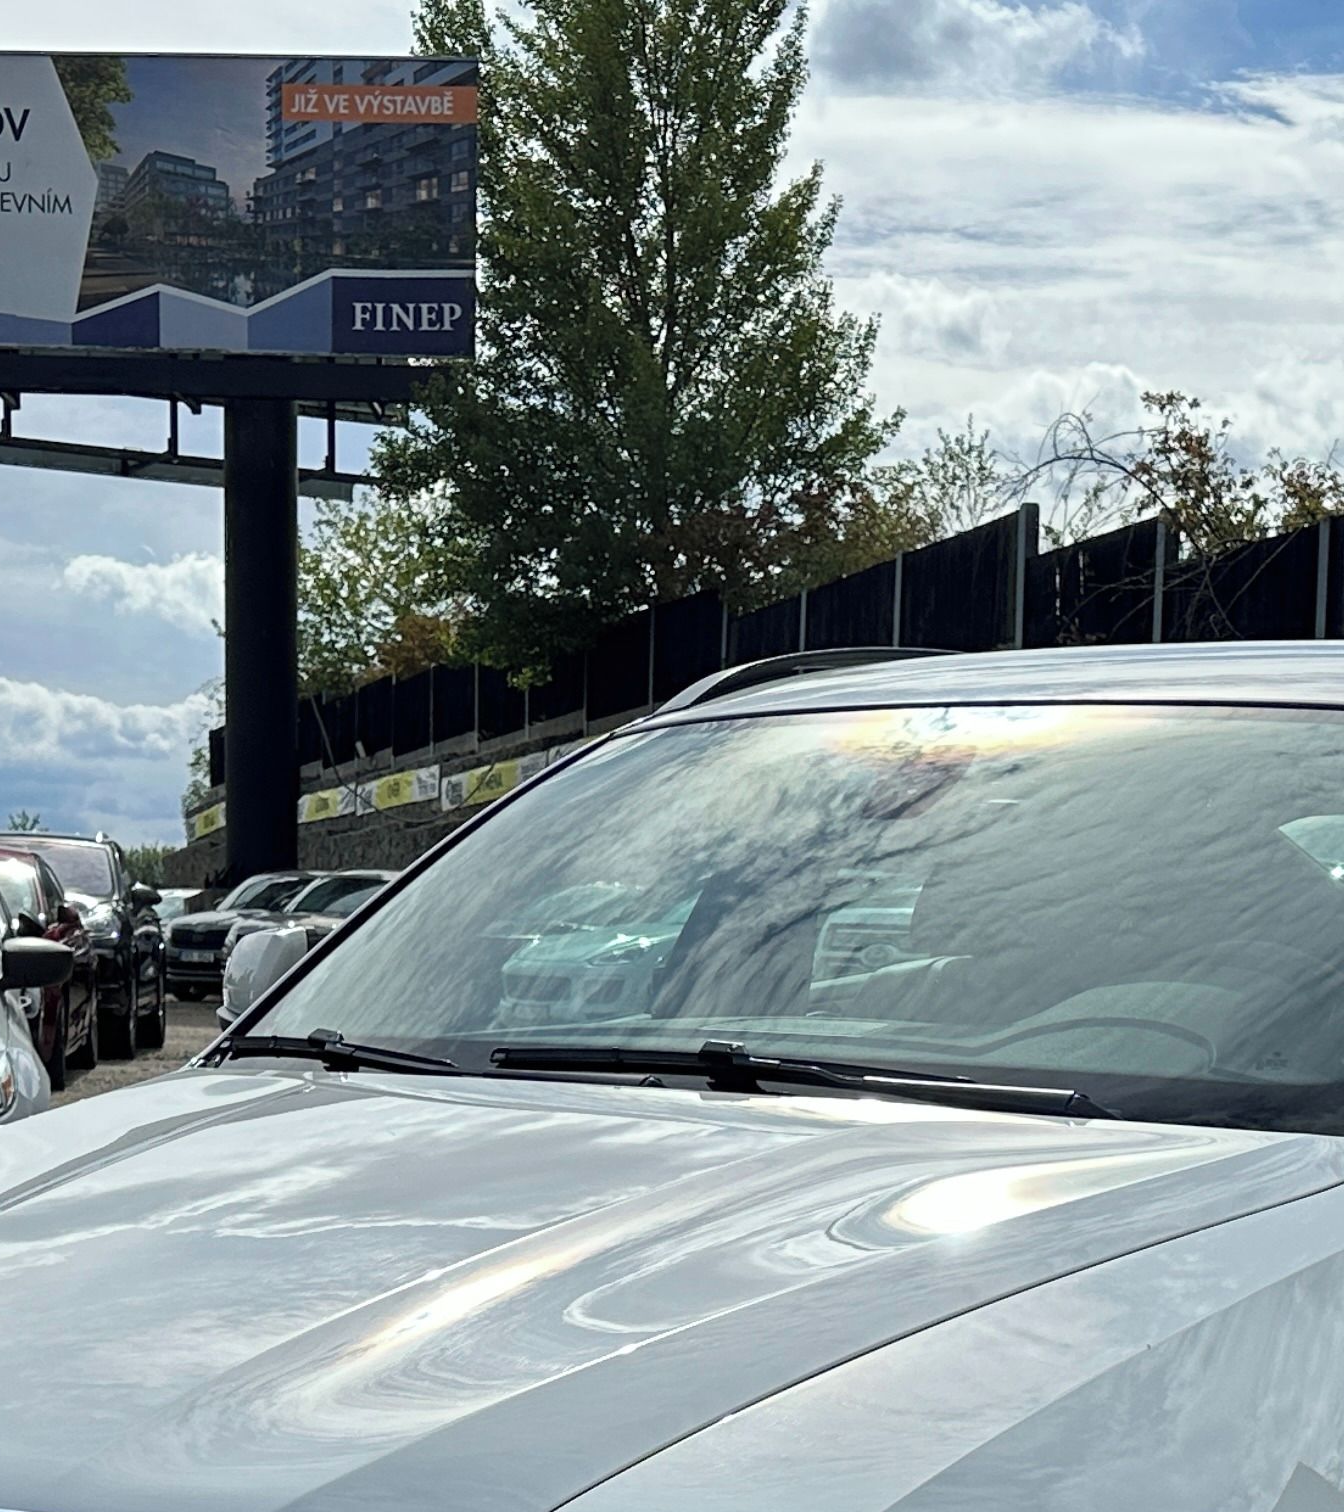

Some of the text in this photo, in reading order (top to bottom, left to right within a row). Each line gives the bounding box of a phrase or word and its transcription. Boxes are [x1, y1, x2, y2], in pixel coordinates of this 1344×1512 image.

[290, 89, 455, 116] JIŽ VE VÝSTAVBĚ
[352, 302, 463, 333] FINEP
